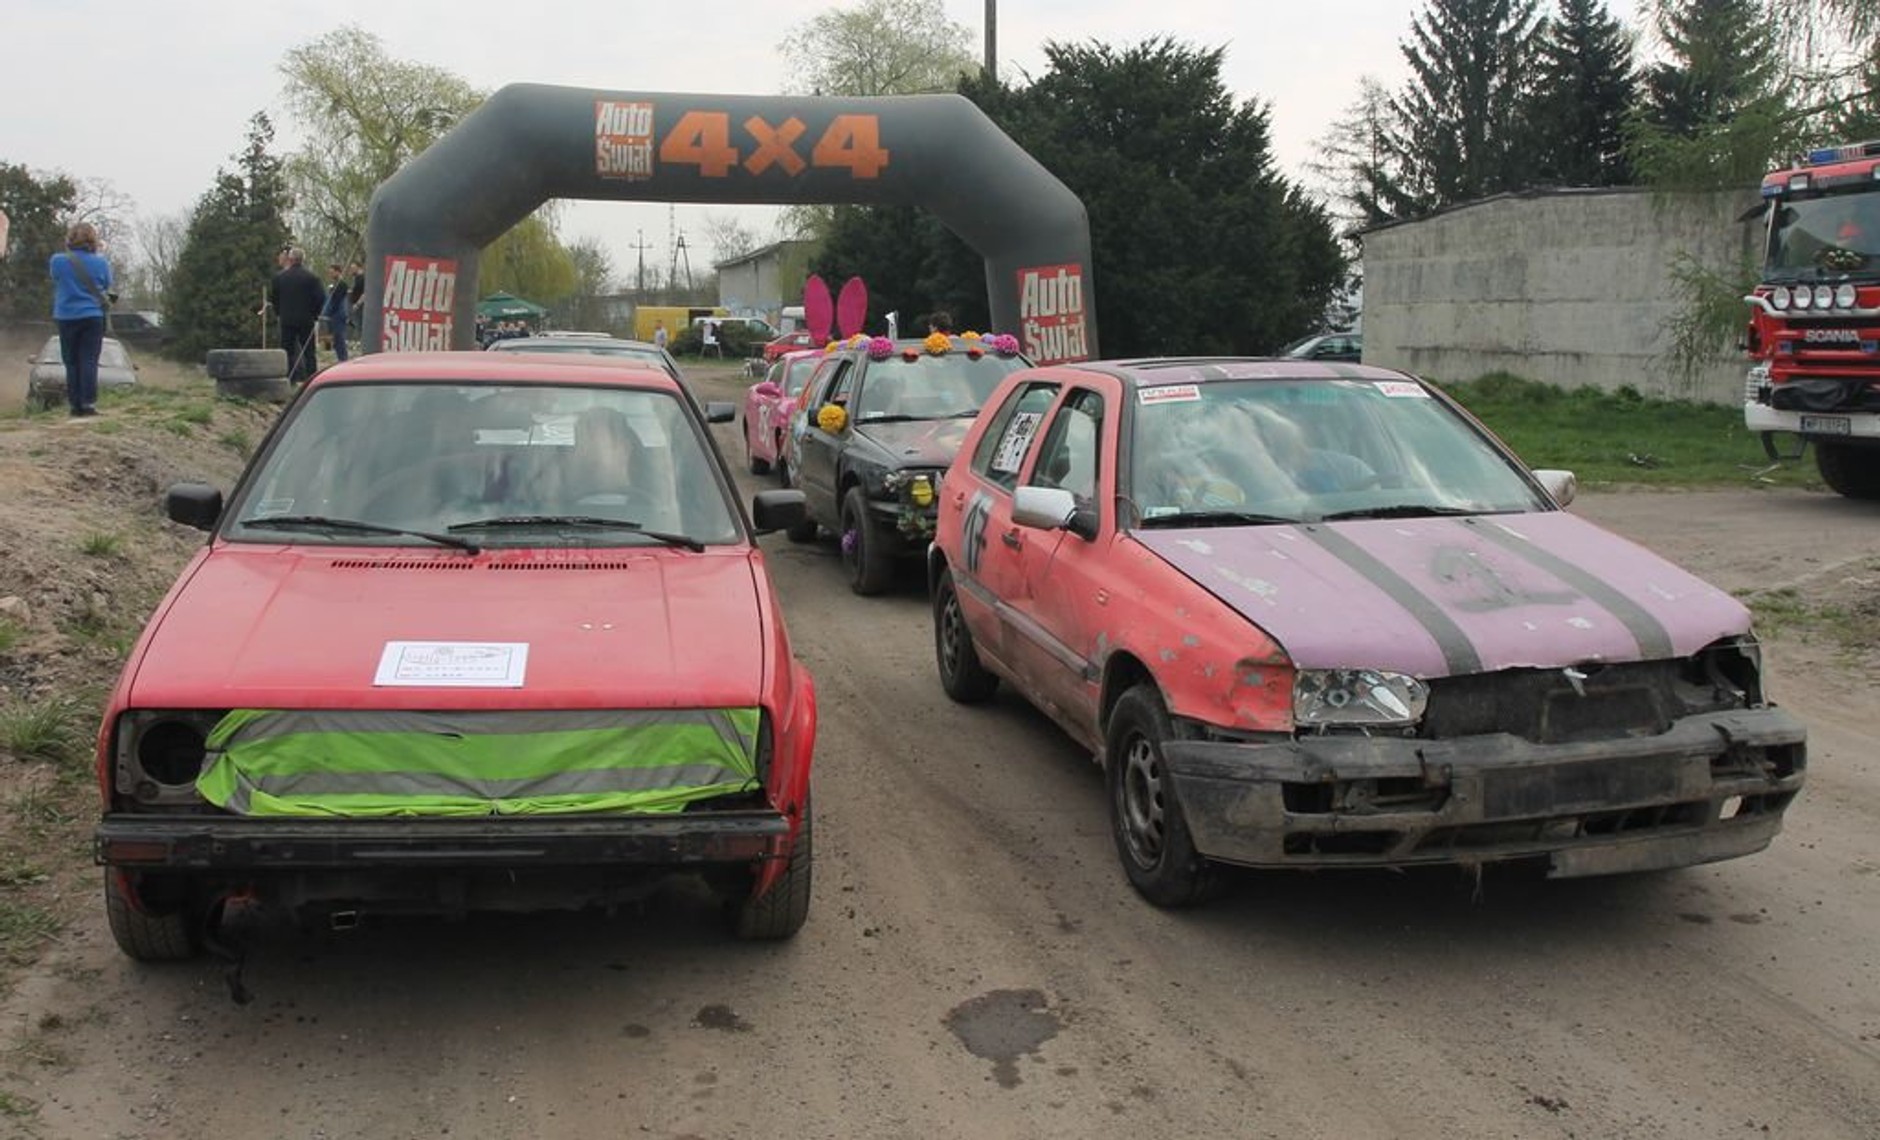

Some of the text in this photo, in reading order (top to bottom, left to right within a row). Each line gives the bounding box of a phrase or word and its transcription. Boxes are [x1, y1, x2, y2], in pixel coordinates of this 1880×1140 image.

[596, 103, 652, 136] Auto
[383, 261, 456, 312] Auto
[1021, 267, 1082, 318] Auto
[1804, 329, 1860, 342] SCANIA
